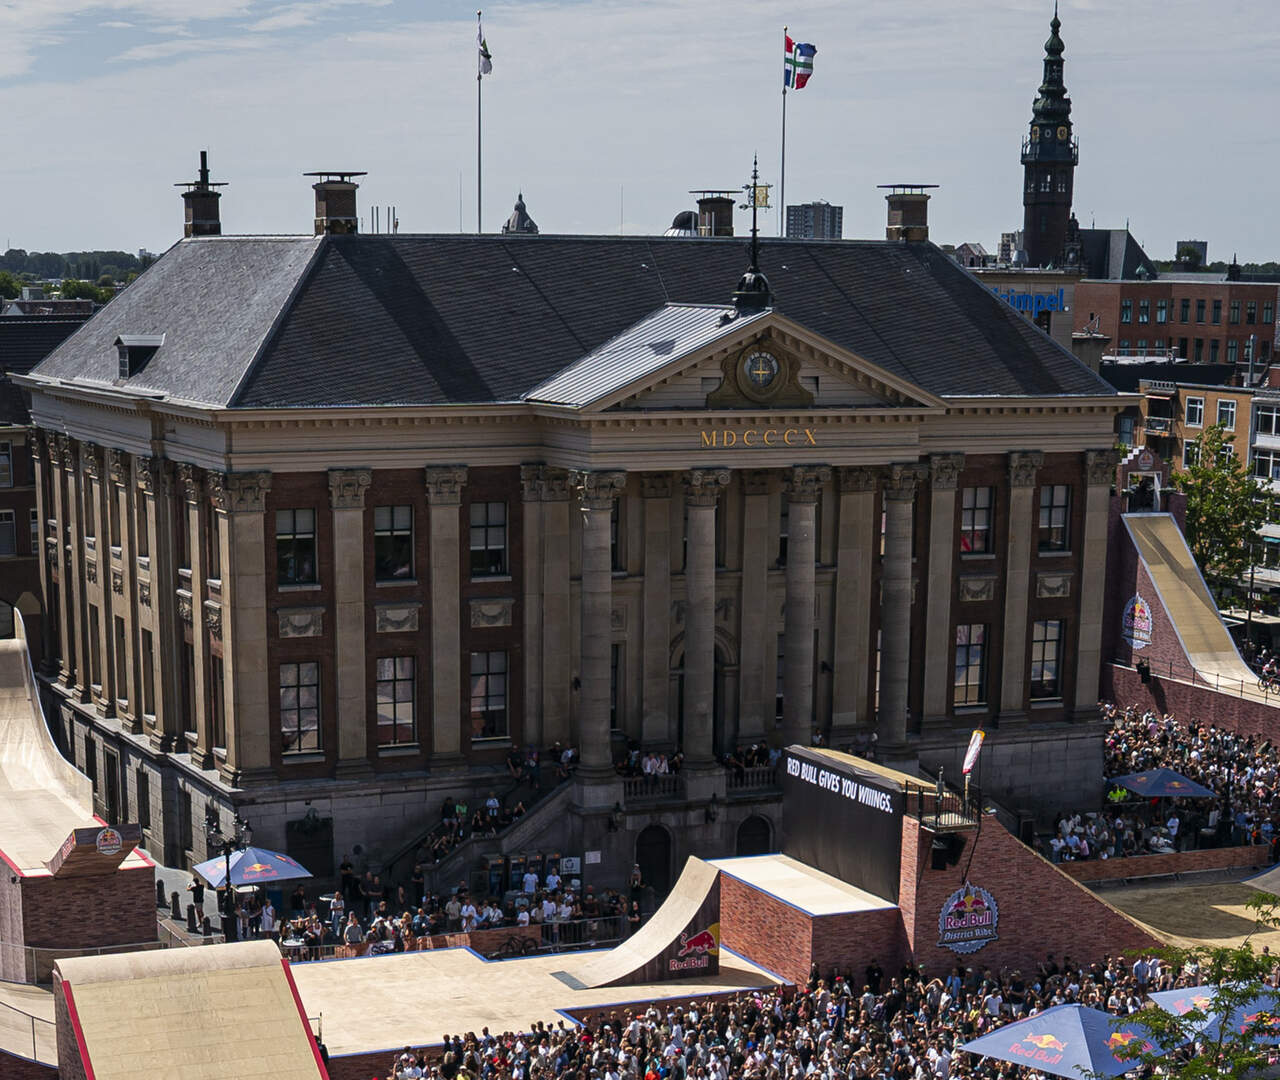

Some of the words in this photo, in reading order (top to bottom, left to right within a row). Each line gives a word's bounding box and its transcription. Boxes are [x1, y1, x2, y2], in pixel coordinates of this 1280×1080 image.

[701, 429, 817, 447] MDCCCX
[787, 758, 800, 777] RED
[801, 763, 818, 785] BULL
[818, 769, 840, 792] GIVES
[841, 777, 858, 800] YOU
[945, 914, 969, 930] Red
[969, 911, 992, 926] Bull
[944, 931, 974, 940] District
[670, 958, 689, 971] Red
[690, 956, 709, 968] Bull
[1008, 1042, 1037, 1057] Red
[1038, 1050, 1065, 1065] Bull
